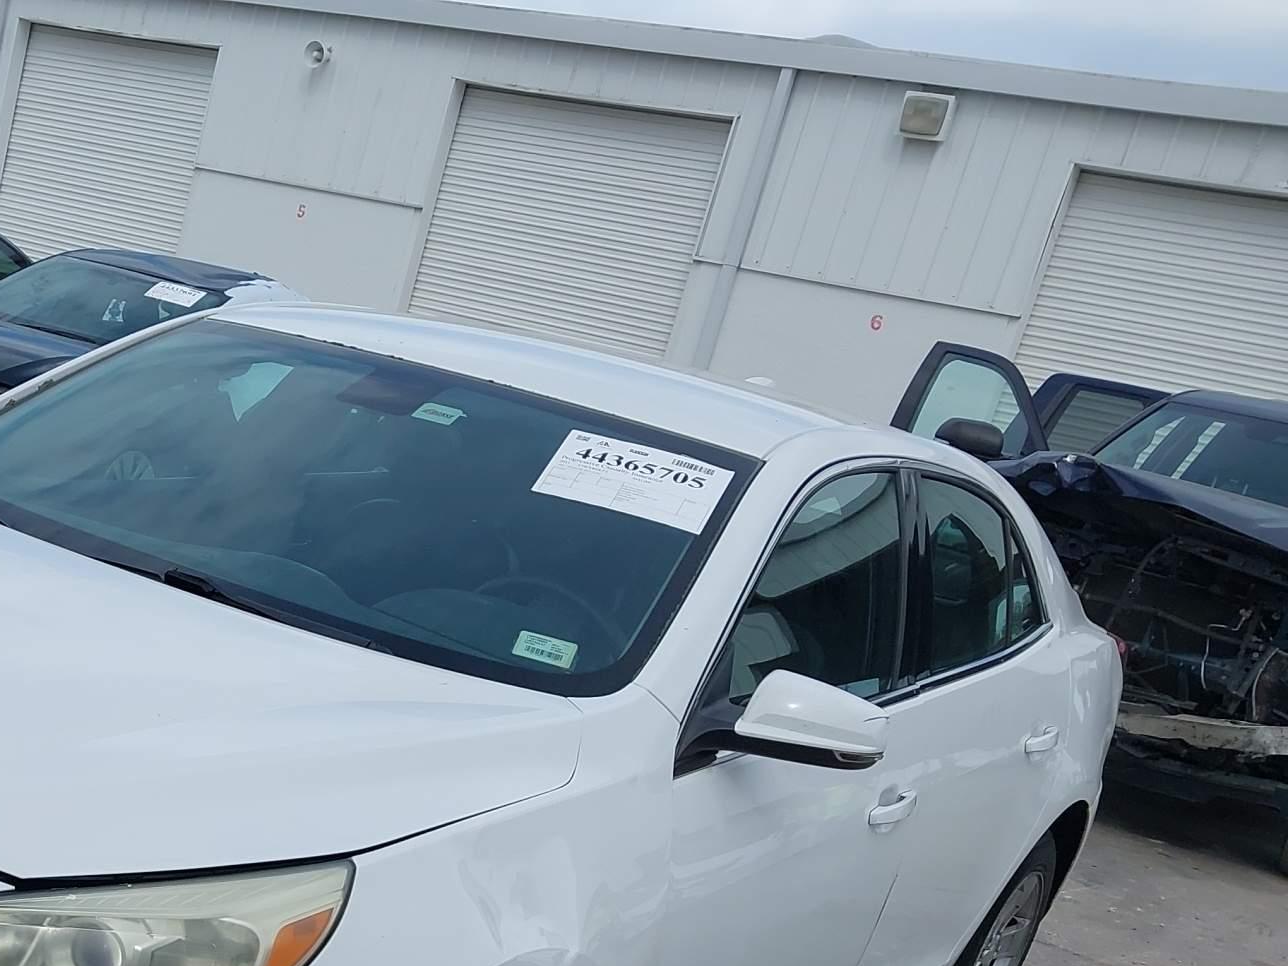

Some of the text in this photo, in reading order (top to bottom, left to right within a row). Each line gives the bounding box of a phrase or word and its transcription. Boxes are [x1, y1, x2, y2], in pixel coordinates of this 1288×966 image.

[297, 204, 306, 218] 5
[871, 314, 883, 331] 6
[575, 447, 707, 489] 44365705
